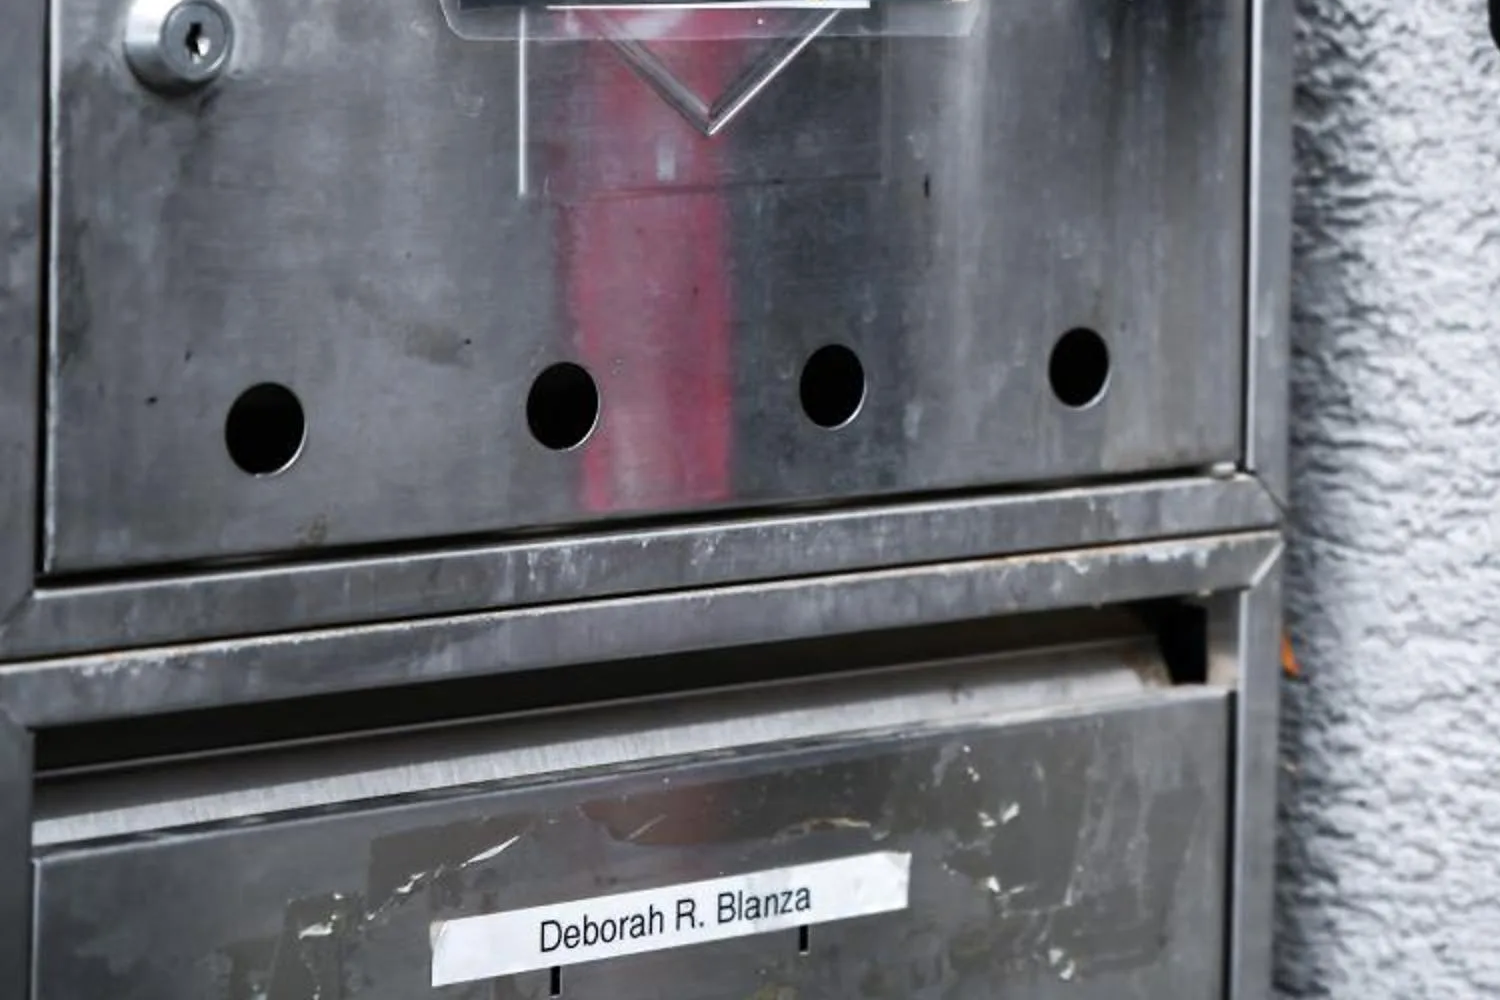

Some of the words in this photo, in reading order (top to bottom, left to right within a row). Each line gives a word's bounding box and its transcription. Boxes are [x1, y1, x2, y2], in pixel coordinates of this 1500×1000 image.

[539, 905, 665, 953] Deborah
[675, 898, 706, 930] R.
[717, 884, 812, 924] Blanza
